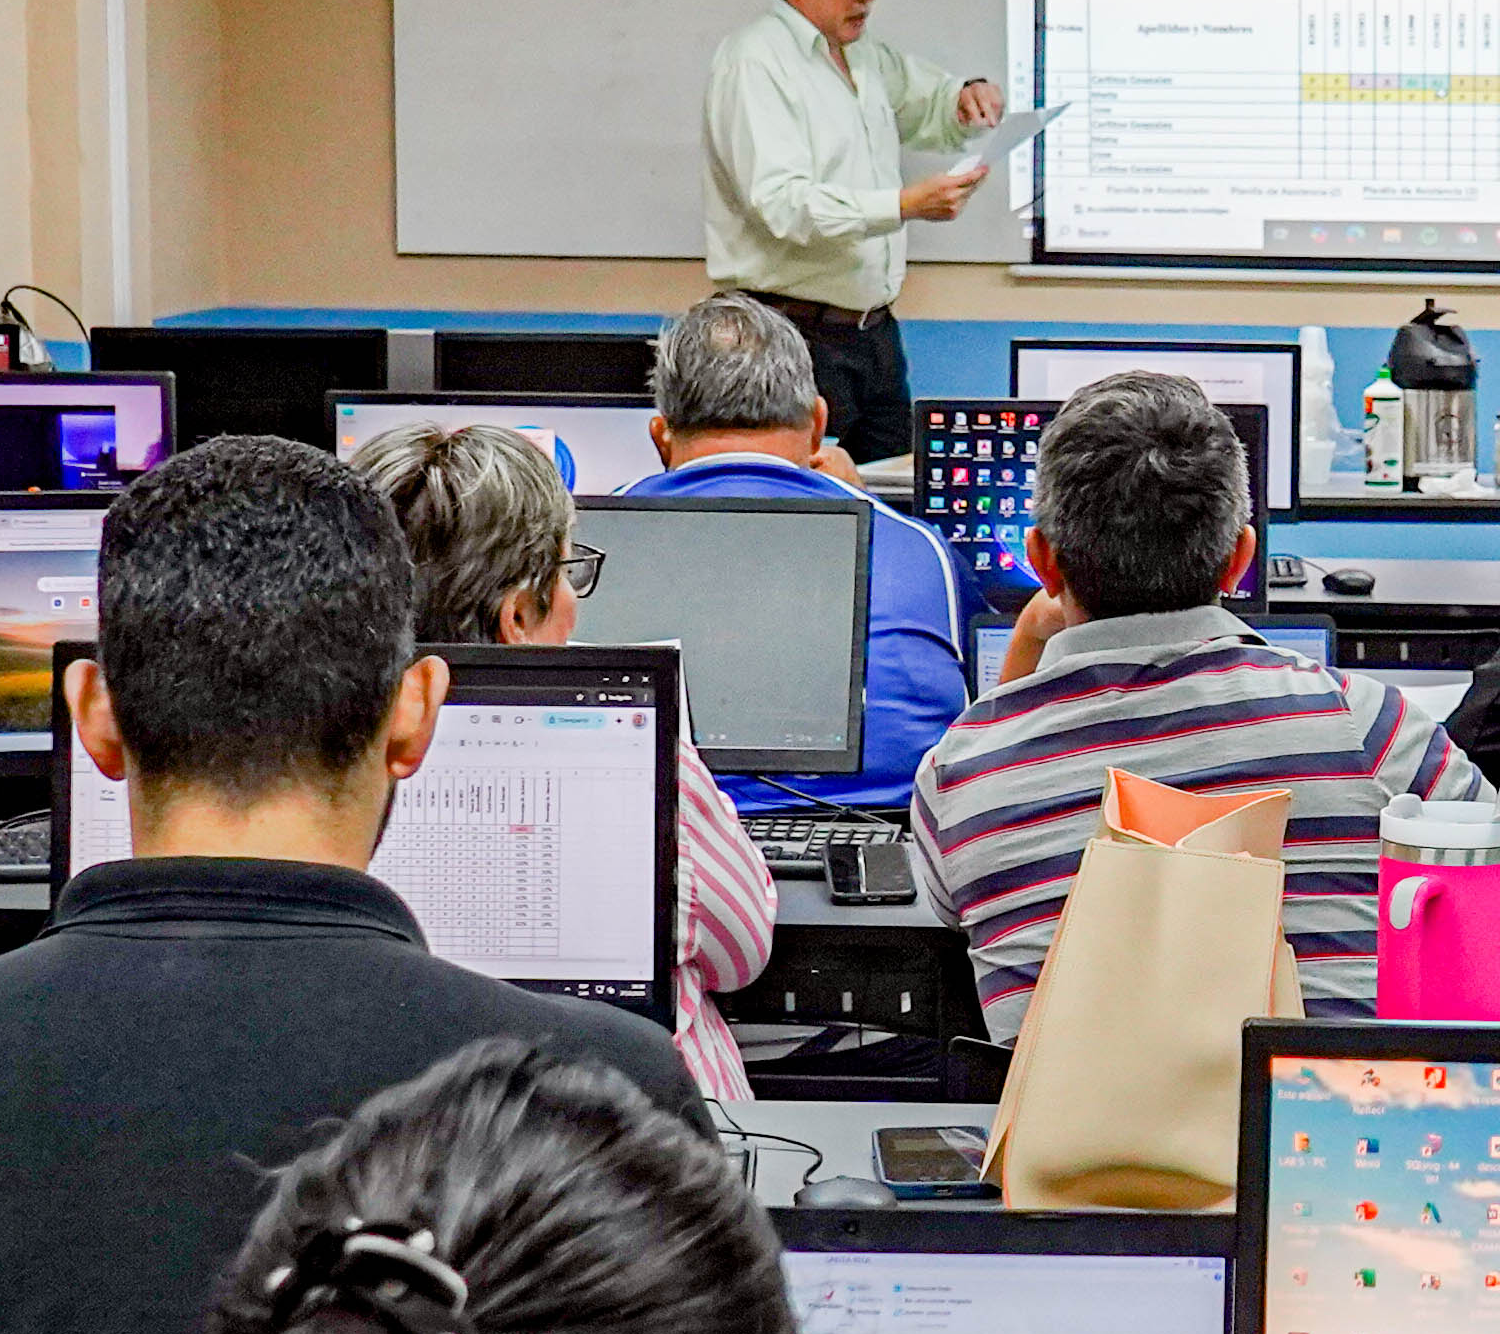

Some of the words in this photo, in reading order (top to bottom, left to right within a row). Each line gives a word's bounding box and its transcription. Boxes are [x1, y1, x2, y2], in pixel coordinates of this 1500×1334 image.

[1138, 23, 1189, 35] Apellidos
[1204, 23, 1252, 35] Nombres
[1143, 186, 1153, 195] de
[1269, 186, 1278, 196] de
[1401, 186, 1412, 196] de
[1355, 1159, 1380, 1168] Word
